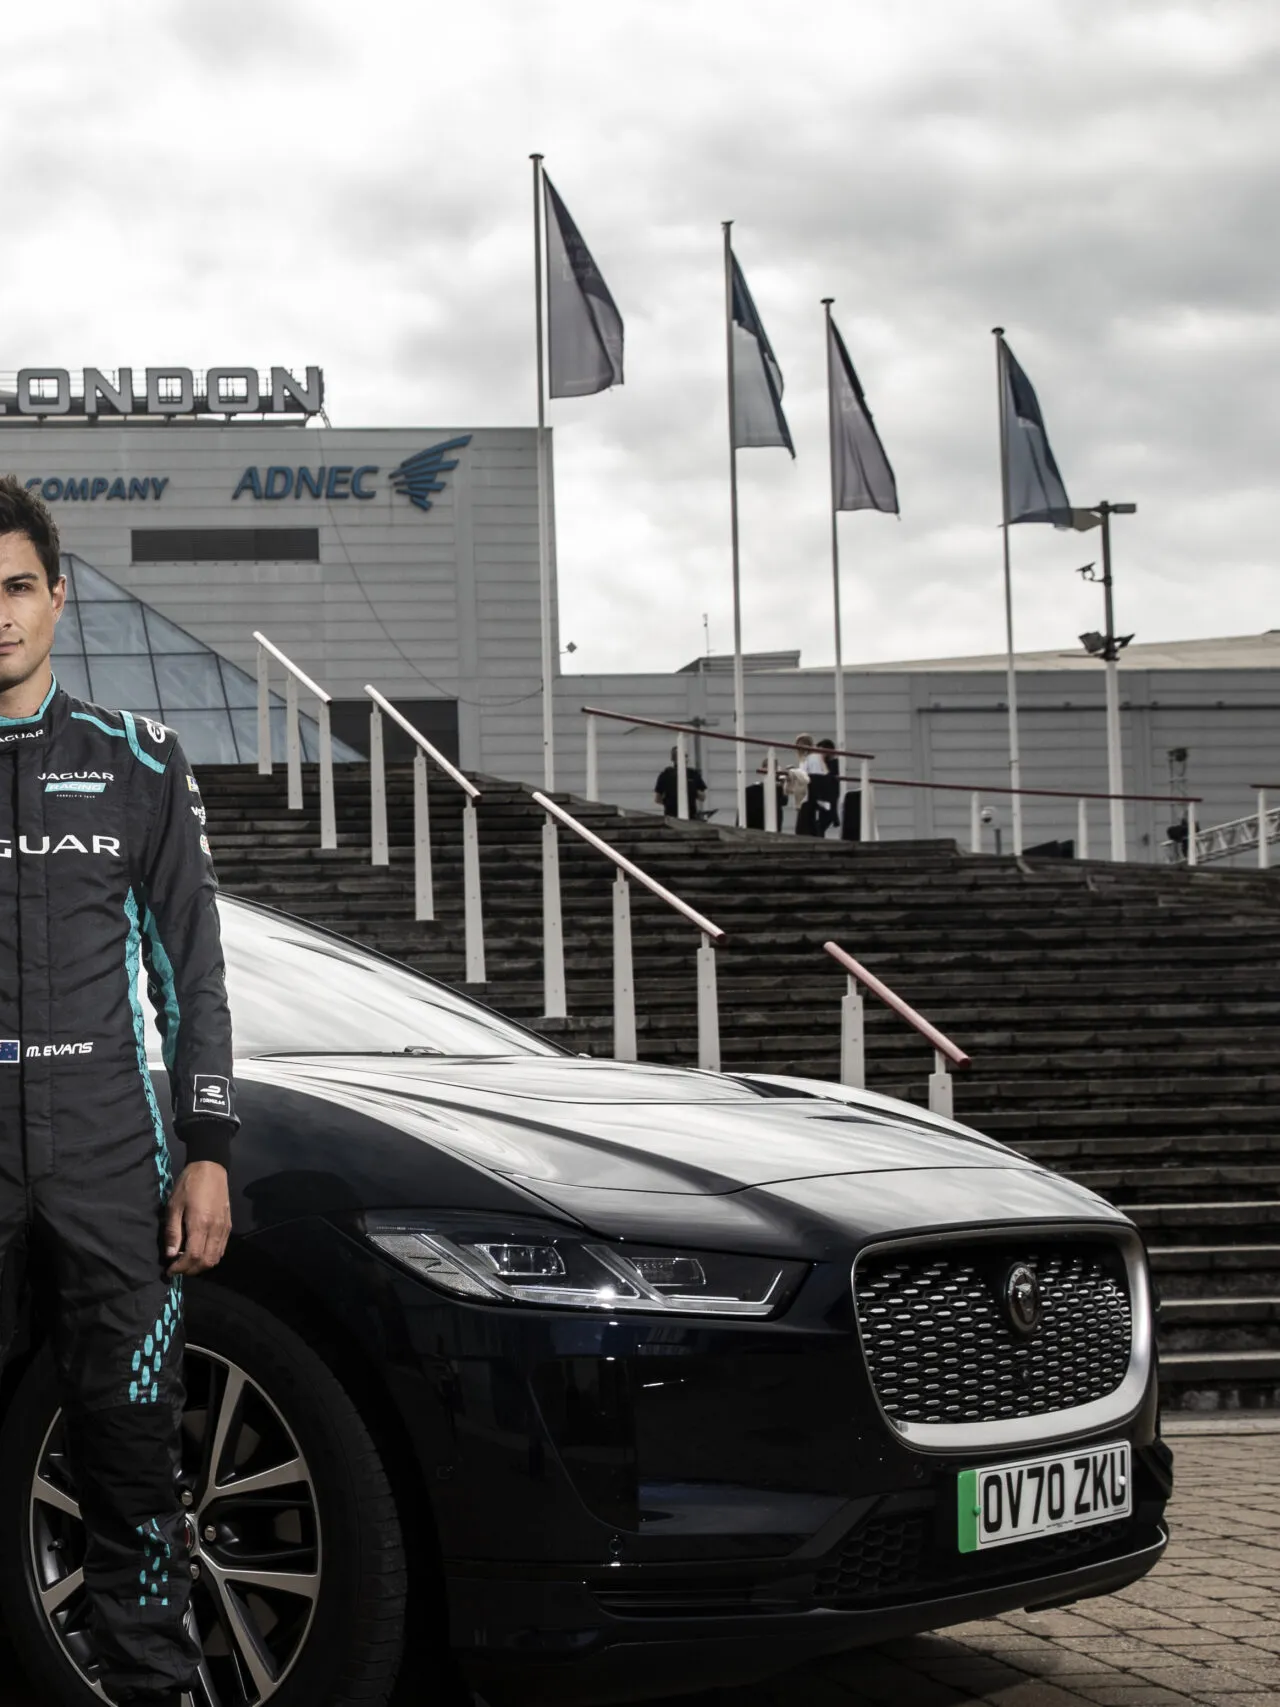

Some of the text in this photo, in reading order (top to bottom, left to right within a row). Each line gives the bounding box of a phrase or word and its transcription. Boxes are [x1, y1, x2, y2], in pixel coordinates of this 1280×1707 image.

[231, 465, 380, 500] ADNEC
[37, 771, 115, 782] JAGUAR
[48, 783, 103, 791] RACING
[984, 1449, 1126, 1534] OV70 ZKU
